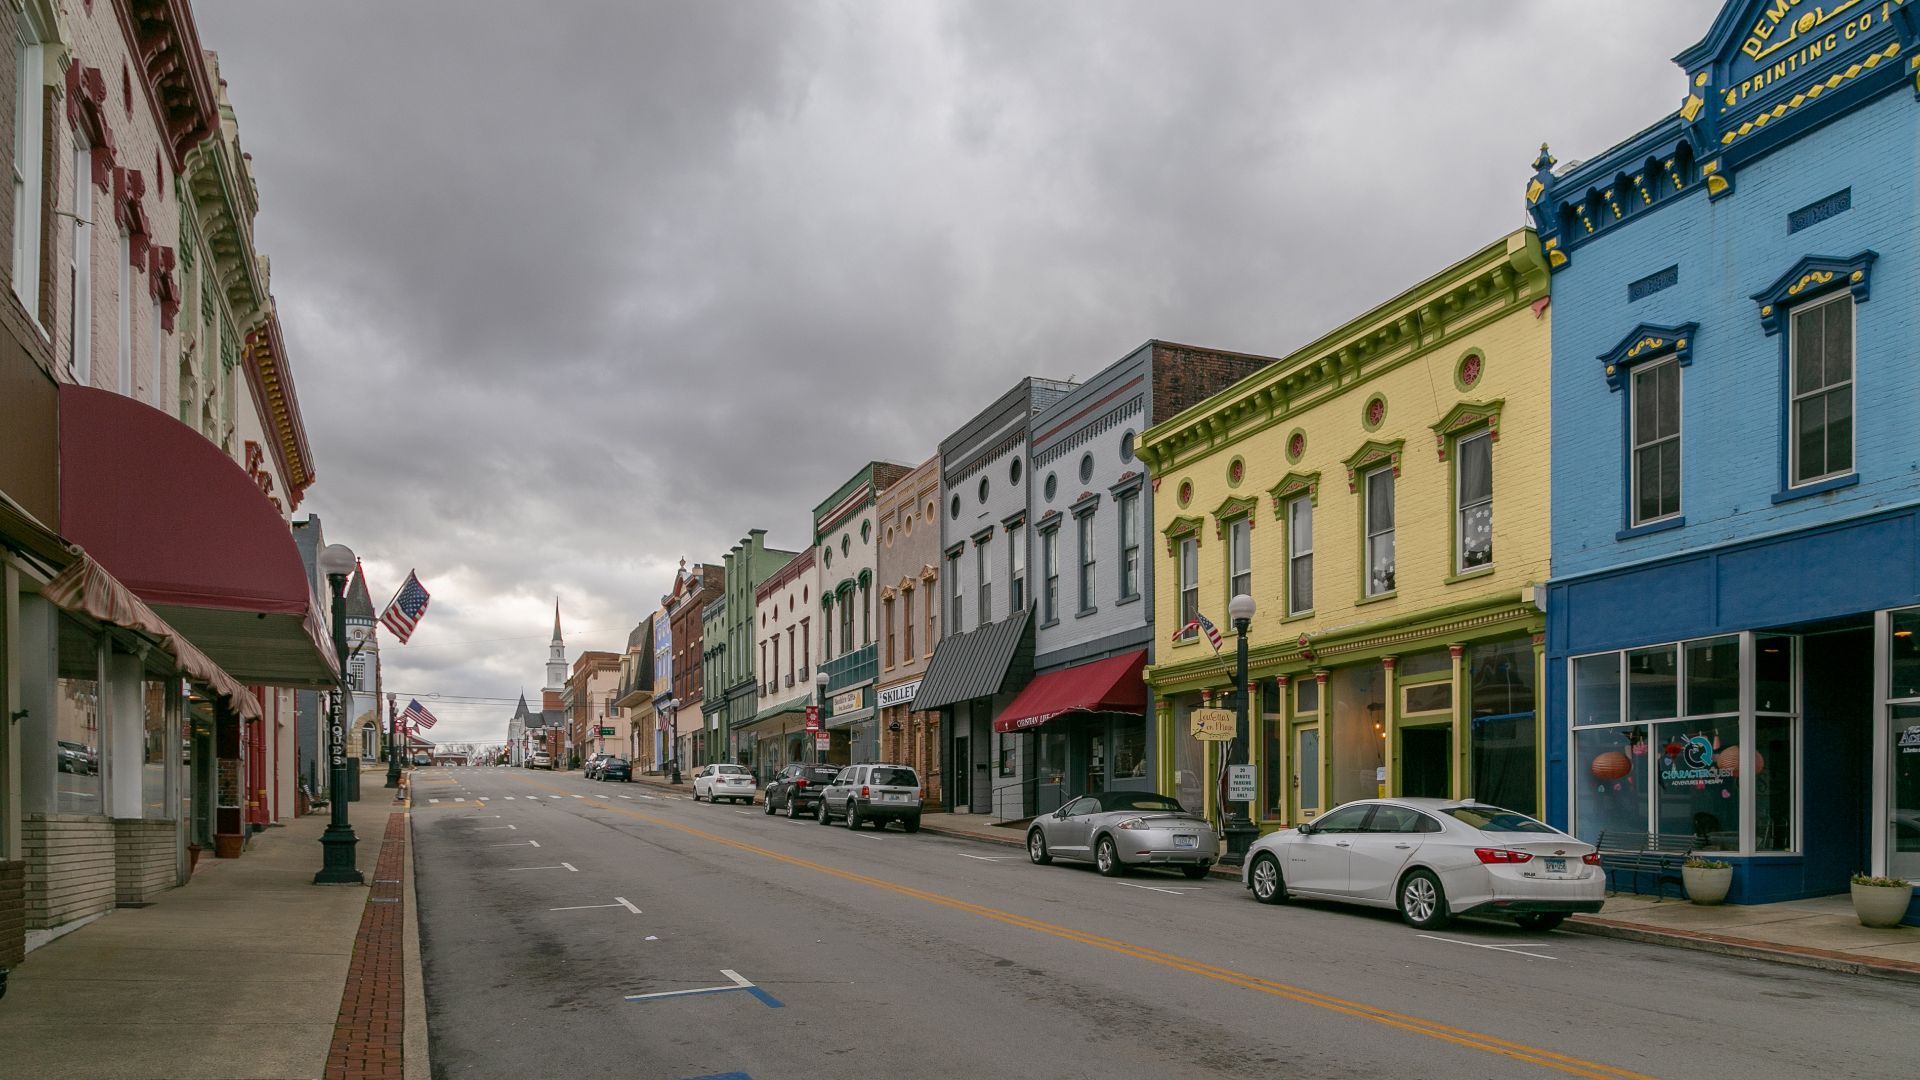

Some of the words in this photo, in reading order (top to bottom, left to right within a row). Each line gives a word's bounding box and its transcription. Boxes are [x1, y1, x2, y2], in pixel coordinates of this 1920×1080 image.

[1742, 0, 1800, 57] DEM
[1741, 33, 1836, 99] PRINTING
[882, 685, 915, 704] SKILLET
